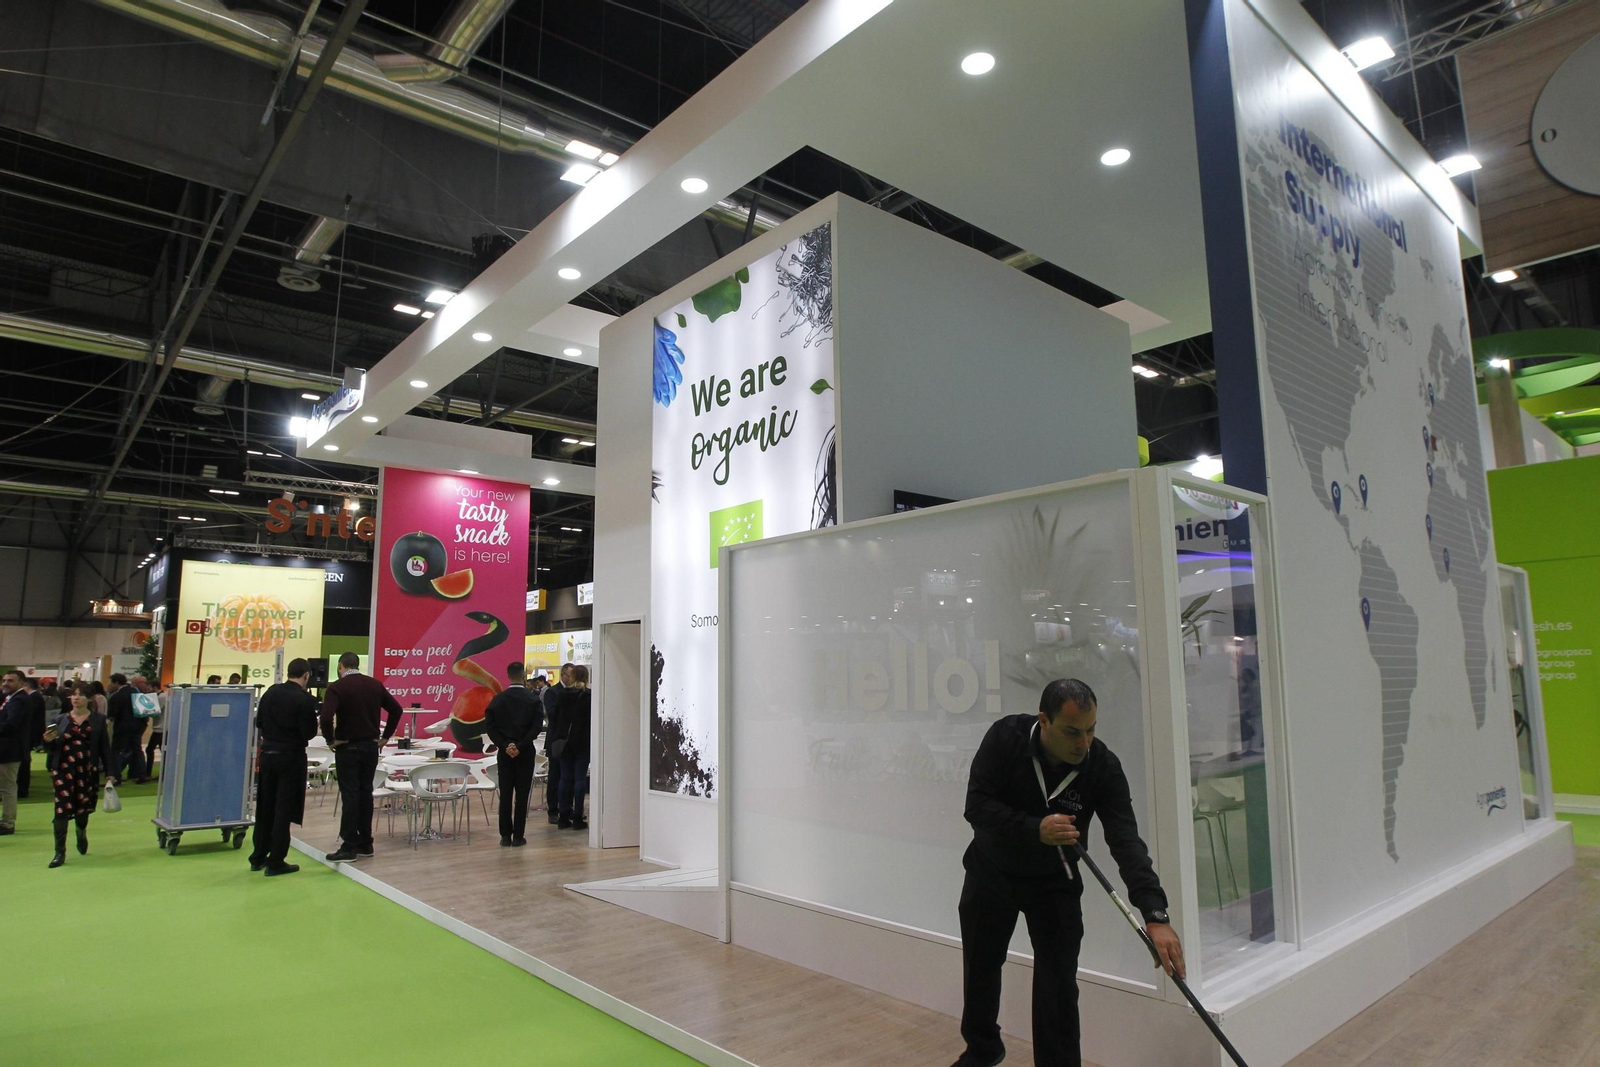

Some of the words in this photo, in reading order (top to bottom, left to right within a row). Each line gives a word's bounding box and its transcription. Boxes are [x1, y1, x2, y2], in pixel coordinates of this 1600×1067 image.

[1278, 113, 1408, 253] International
[1284, 170, 1360, 268] Supply
[690, 374, 731, 417] We
[740, 355, 788, 399] are
[454, 484, 484, 498] Your
[487, 490, 515, 501] new
[456, 497, 509, 530] tasty
[453, 523, 512, 546] snack
[454, 546, 466, 561] is
[471, 548, 510, 564] here!
[202, 602, 239, 618] The
[245, 608, 305, 622] power
[384, 647, 410, 658] Easy
[411, 648, 423, 656] to
[426, 643, 453, 662] peel
[383, 667, 409, 678] Easy
[411, 667, 423, 676] to
[427, 662, 447, 676] eat
[814, 640, 1001, 713] Hello!
[410, 687, 422, 695] to
[426, 683, 455, 702] enjoy
